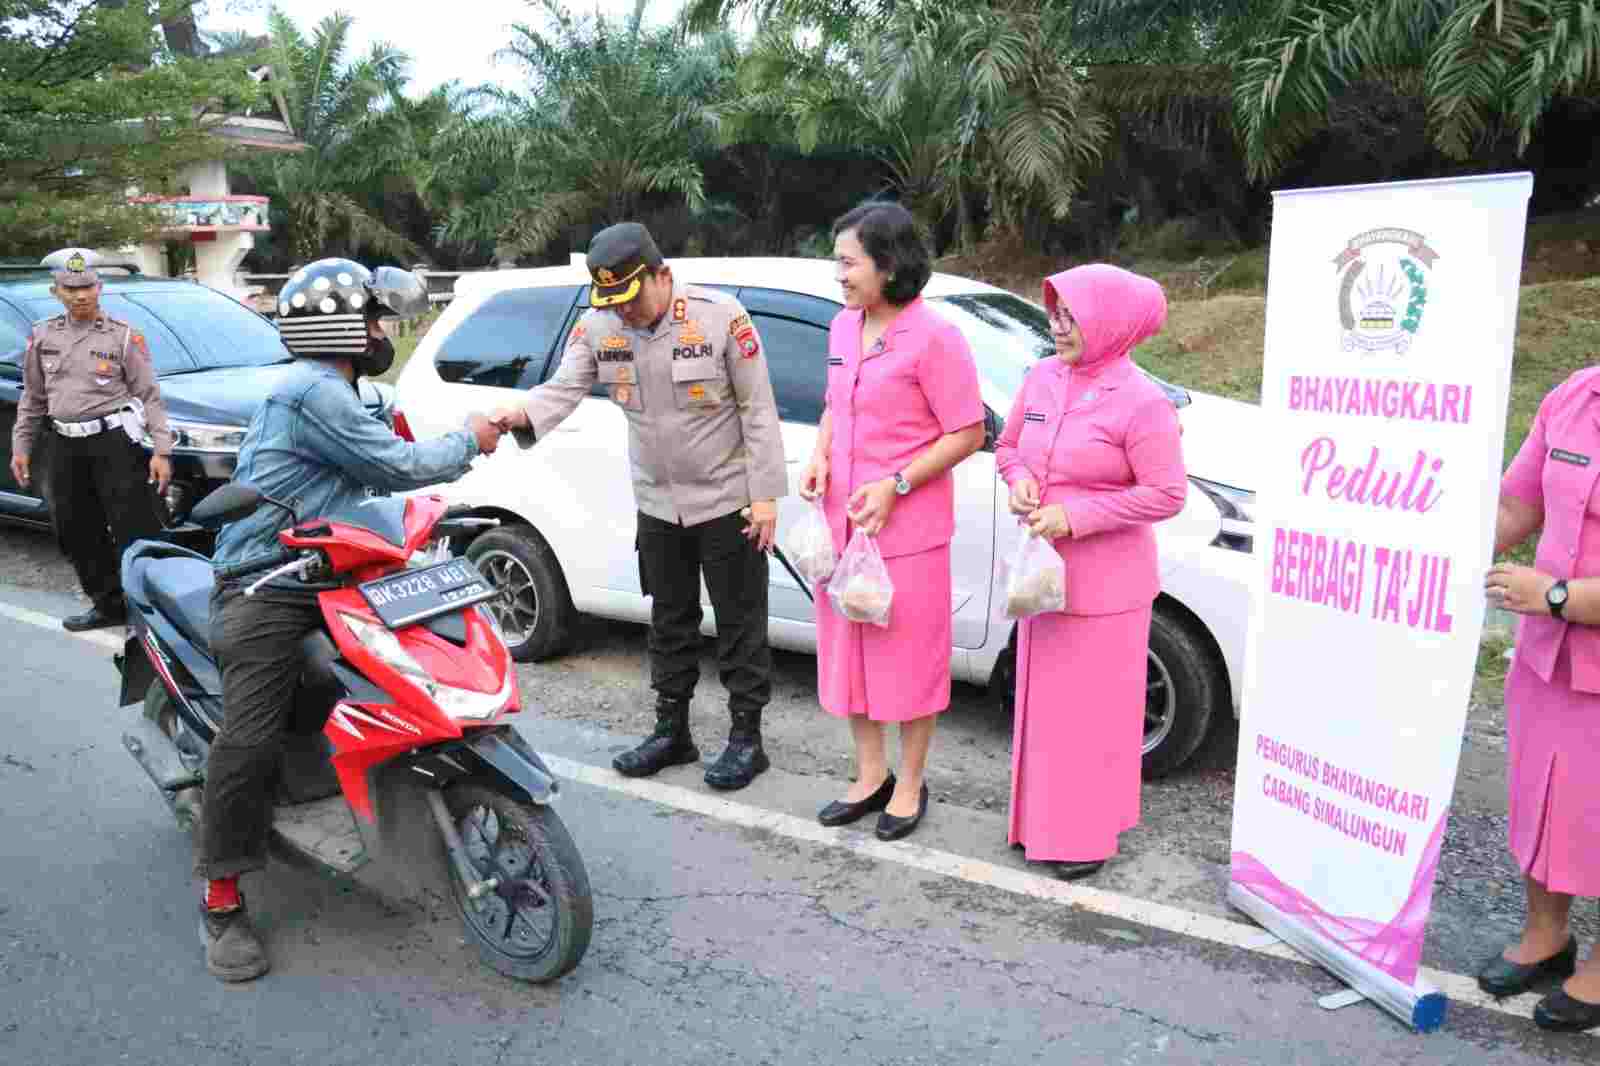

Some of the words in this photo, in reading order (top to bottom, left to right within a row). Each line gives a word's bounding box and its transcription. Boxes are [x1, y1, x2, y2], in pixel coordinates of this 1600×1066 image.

[672, 344, 713, 361] POLRI
[1287, 375, 1473, 425] BHAYANGKARI
[1301, 436, 1445, 515] Peduli
[1271, 527, 1367, 615] BERBAGI
[1371, 546, 1453, 633] TA'JIL
[1255, 733, 1319, 783] PENGURUS
[1322, 761, 1430, 822] BHAYANGKARI
[1263, 773, 1312, 816] CABANG
[1312, 797, 1408, 857] SIMALUNGUN
